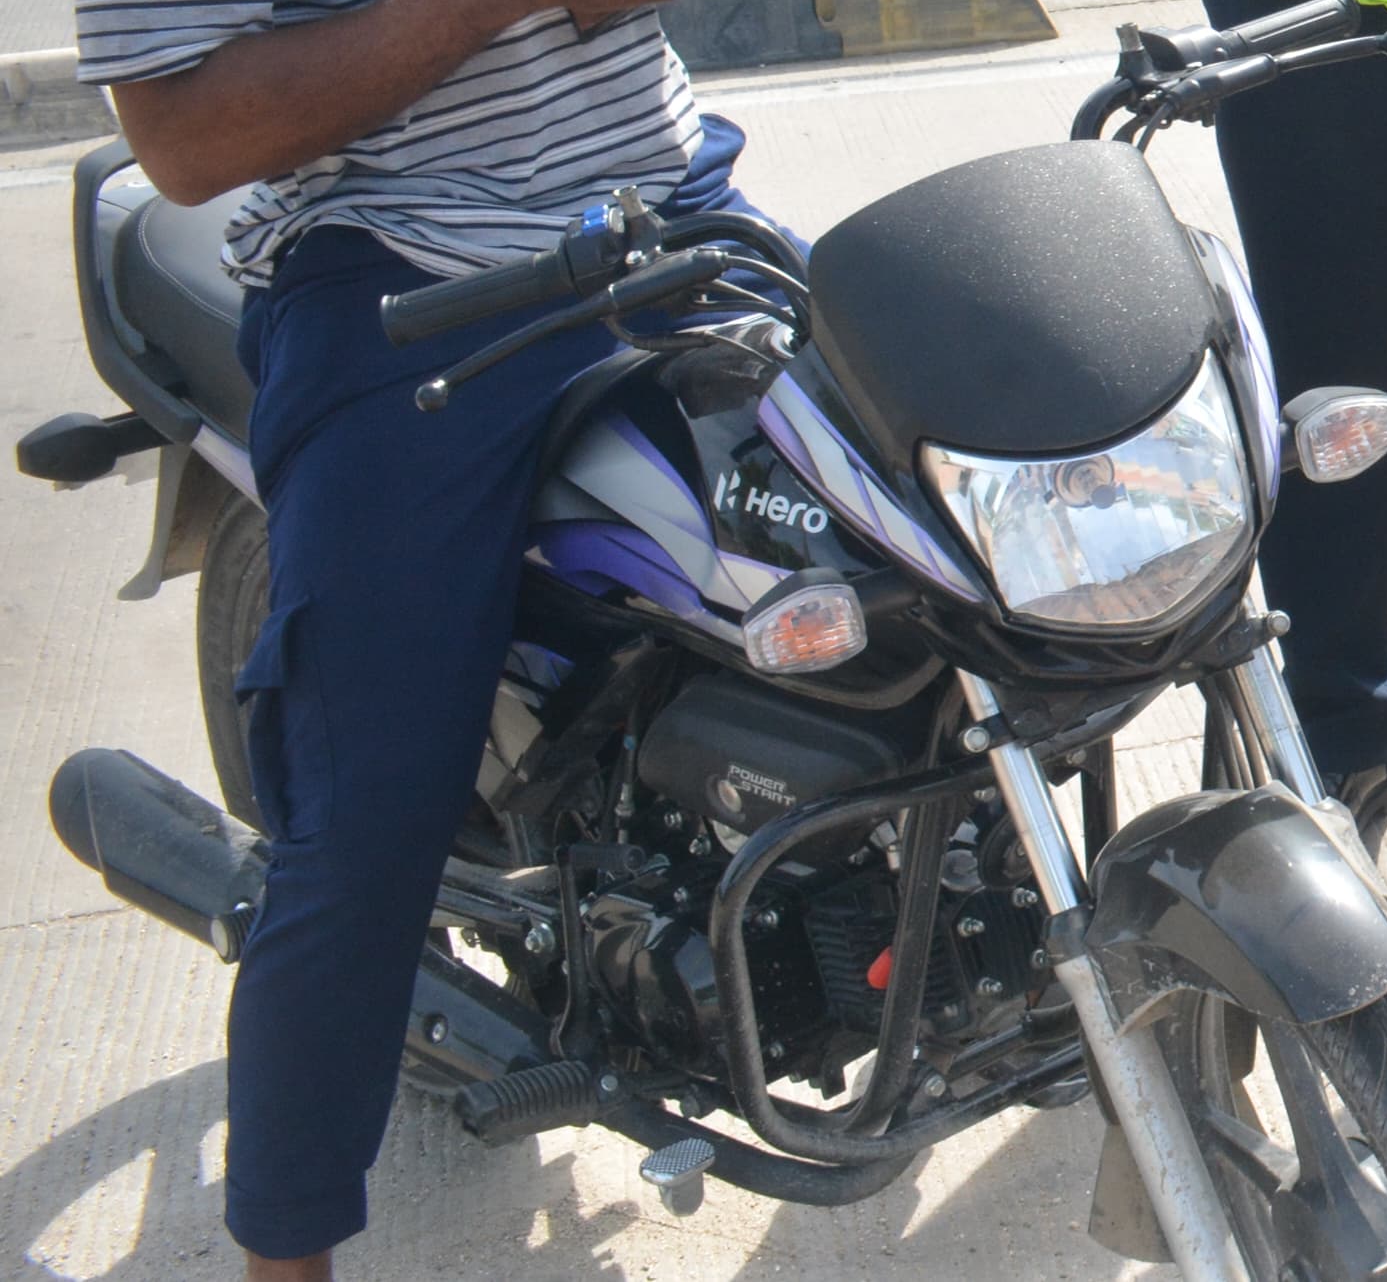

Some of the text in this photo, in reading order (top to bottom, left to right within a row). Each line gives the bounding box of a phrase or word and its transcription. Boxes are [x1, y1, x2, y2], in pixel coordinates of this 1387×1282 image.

[744, 486, 829, 534] Hero
[729, 764, 787, 793] POWER
[741, 780, 796, 807] START
